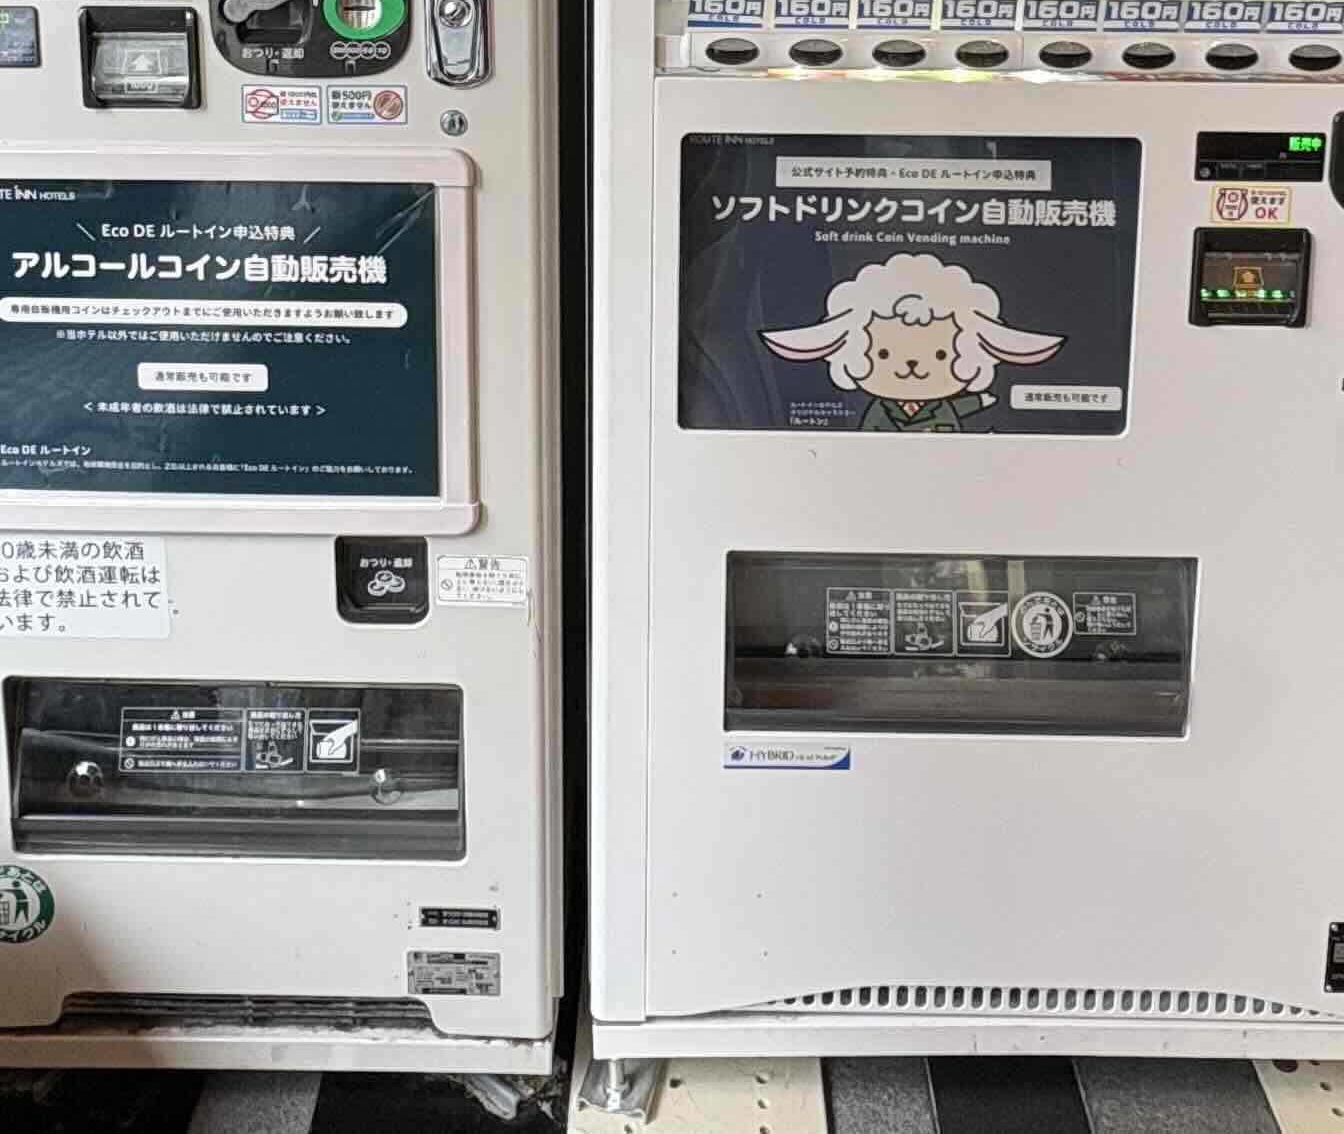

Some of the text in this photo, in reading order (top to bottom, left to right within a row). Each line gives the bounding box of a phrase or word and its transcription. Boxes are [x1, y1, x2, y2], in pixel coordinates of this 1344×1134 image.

[946, 0, 1014, 19] 160円
[1027, 1, 1097, 20] 160円
[1109, 1, 1179, 21] 160円
[1191, 3, 1260, 22] 160円
[1274, 3, 1343, 23] 160円
[711, 195, 1117, 228] ソフトドリンクコイン自動販売機
[1255, 206, 1278, 220] OK
[101, 223, 296, 242] Eco DE ルートイン申込特典
[907, 232, 957, 246] Vending
[11, 250, 388, 286] アルコールコイン自動販売機
